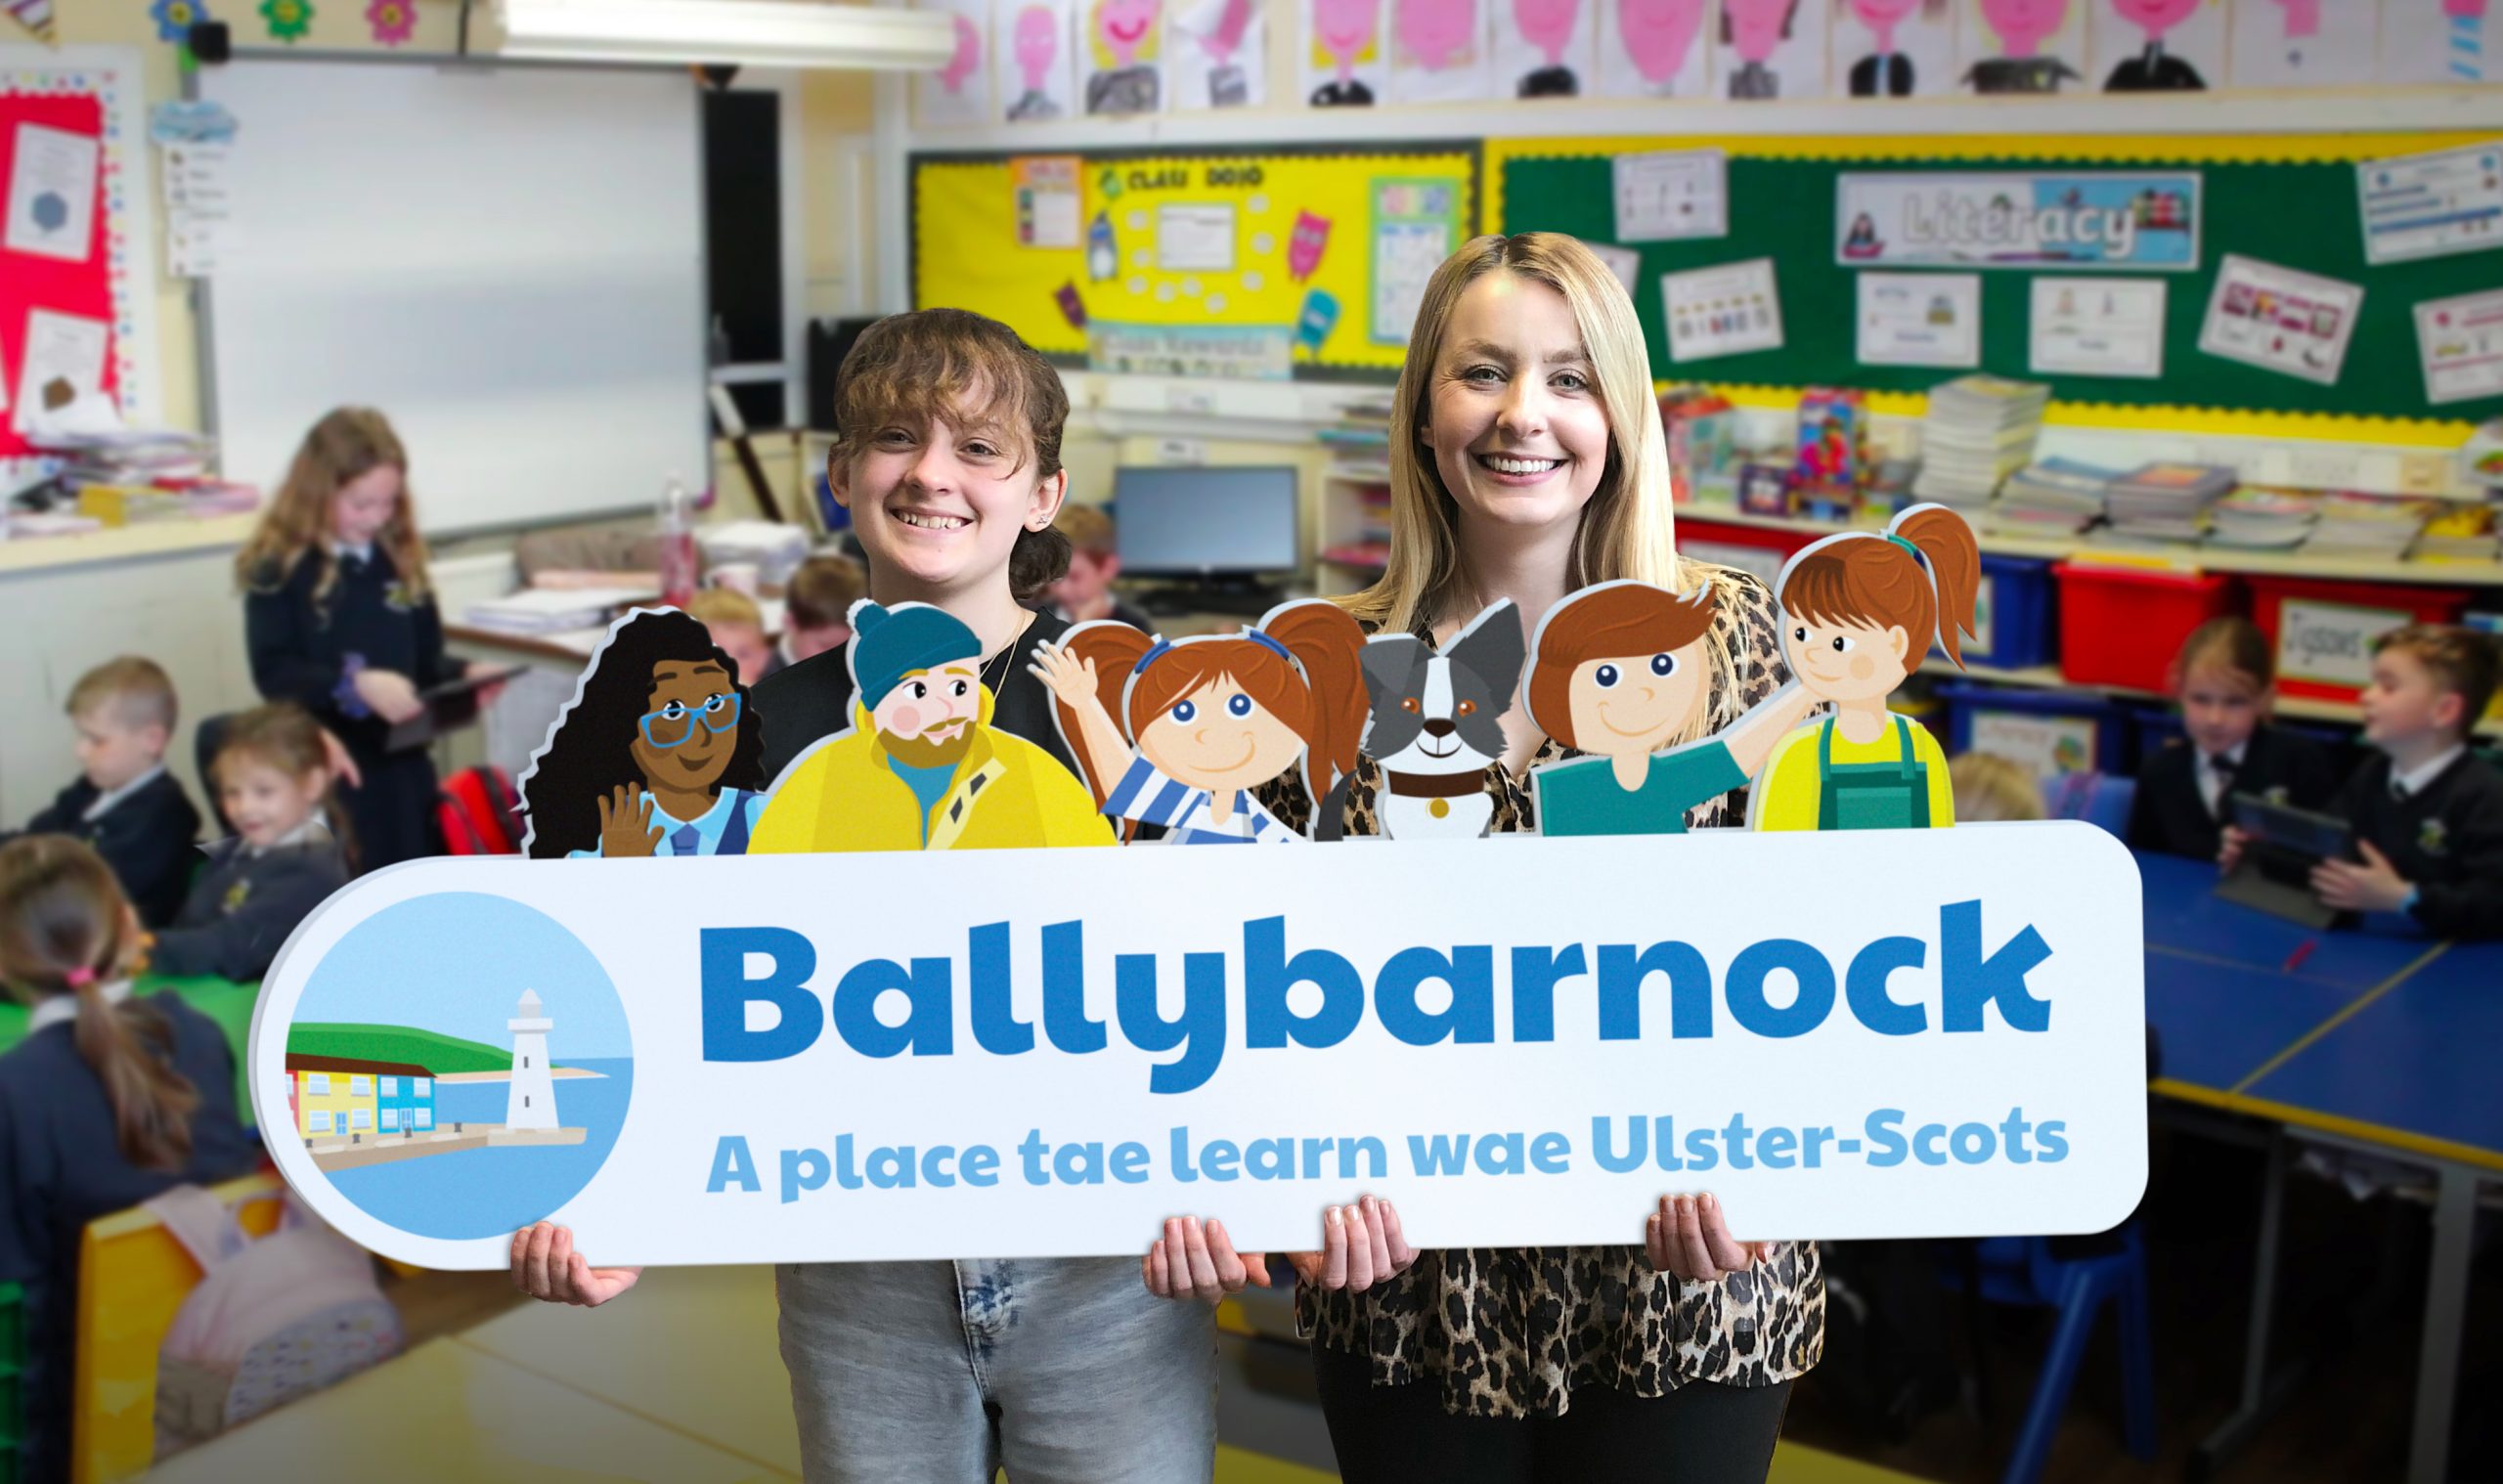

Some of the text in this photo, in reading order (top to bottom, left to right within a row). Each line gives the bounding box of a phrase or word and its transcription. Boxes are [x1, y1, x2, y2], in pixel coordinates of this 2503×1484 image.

[1206, 165, 1263, 189] DOJO
[1903, 190, 2136, 259] Literacy
[698, 898, 2054, 1096] Ballybarnock
[705, 1106, 2070, 1205] A place tae learn wae Ulster-Scots
